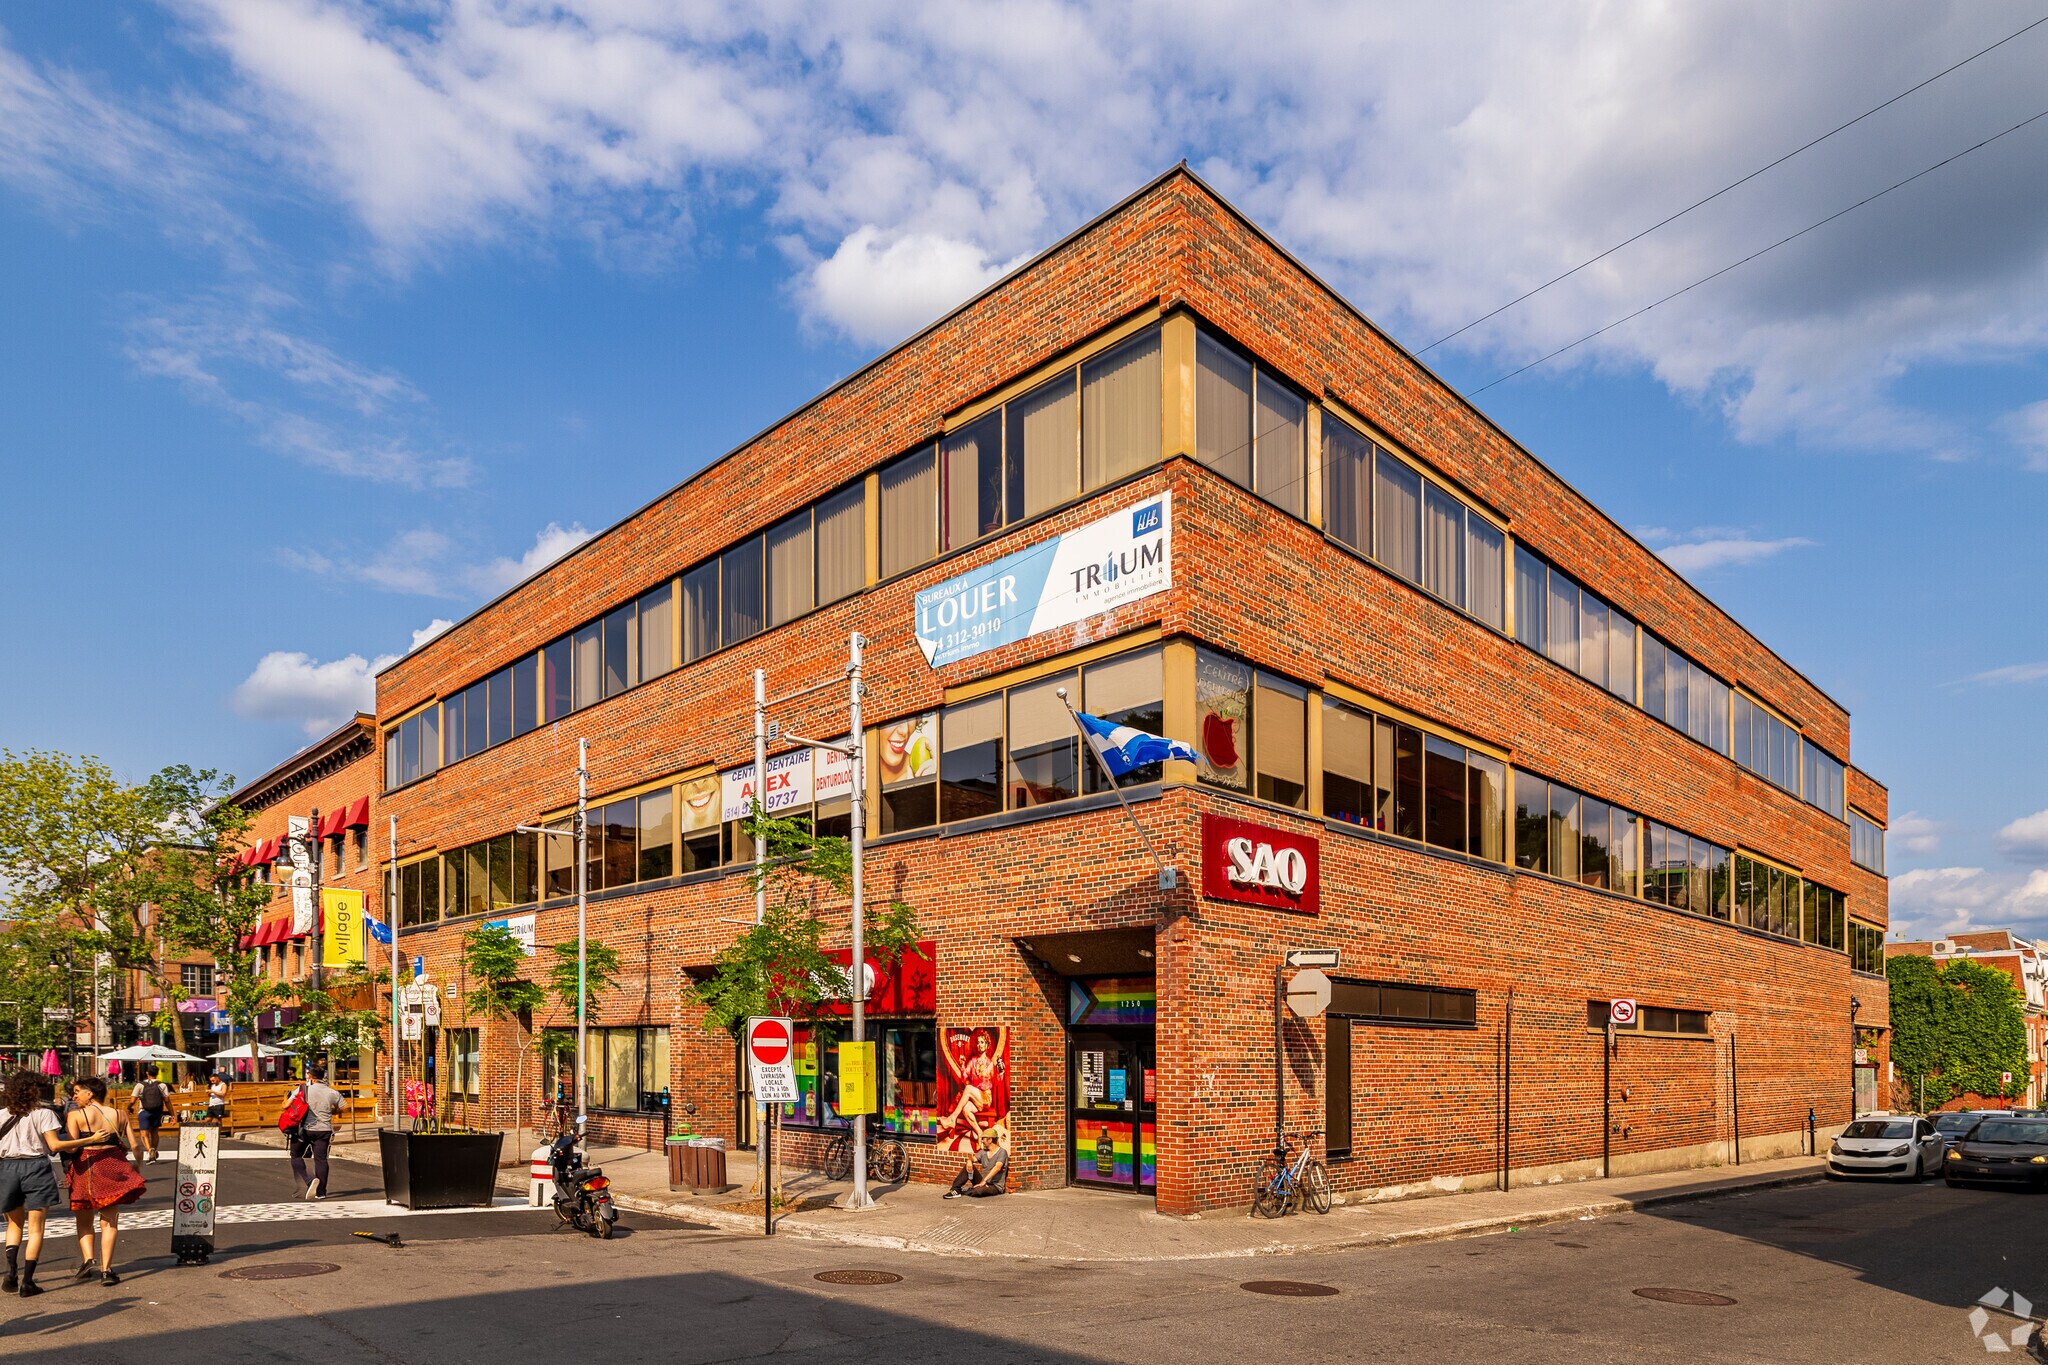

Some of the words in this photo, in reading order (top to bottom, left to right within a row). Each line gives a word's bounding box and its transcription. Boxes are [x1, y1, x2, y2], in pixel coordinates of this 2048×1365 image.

[922, 582, 961, 605] BUREAUX
[961, 577, 969, 590] À
[1075, 567, 1163, 604] IMMOBILIER
[1104, 591, 1126, 604] agence
[922, 574, 1018, 635] LOUER
[946, 617, 1001, 648] 312-3010
[1205, 664, 1244, 687] CENTRE
[732, 766, 757, 782] CENT
[767, 751, 811, 773] DENTAIRE
[725, 806, 740, 820] (514)
[768, 789, 798, 809] 9737
[1225, 836, 1307, 895] SAQ
[335, 902, 351, 956] village
[1121, 1000, 1141, 1008] 1250
